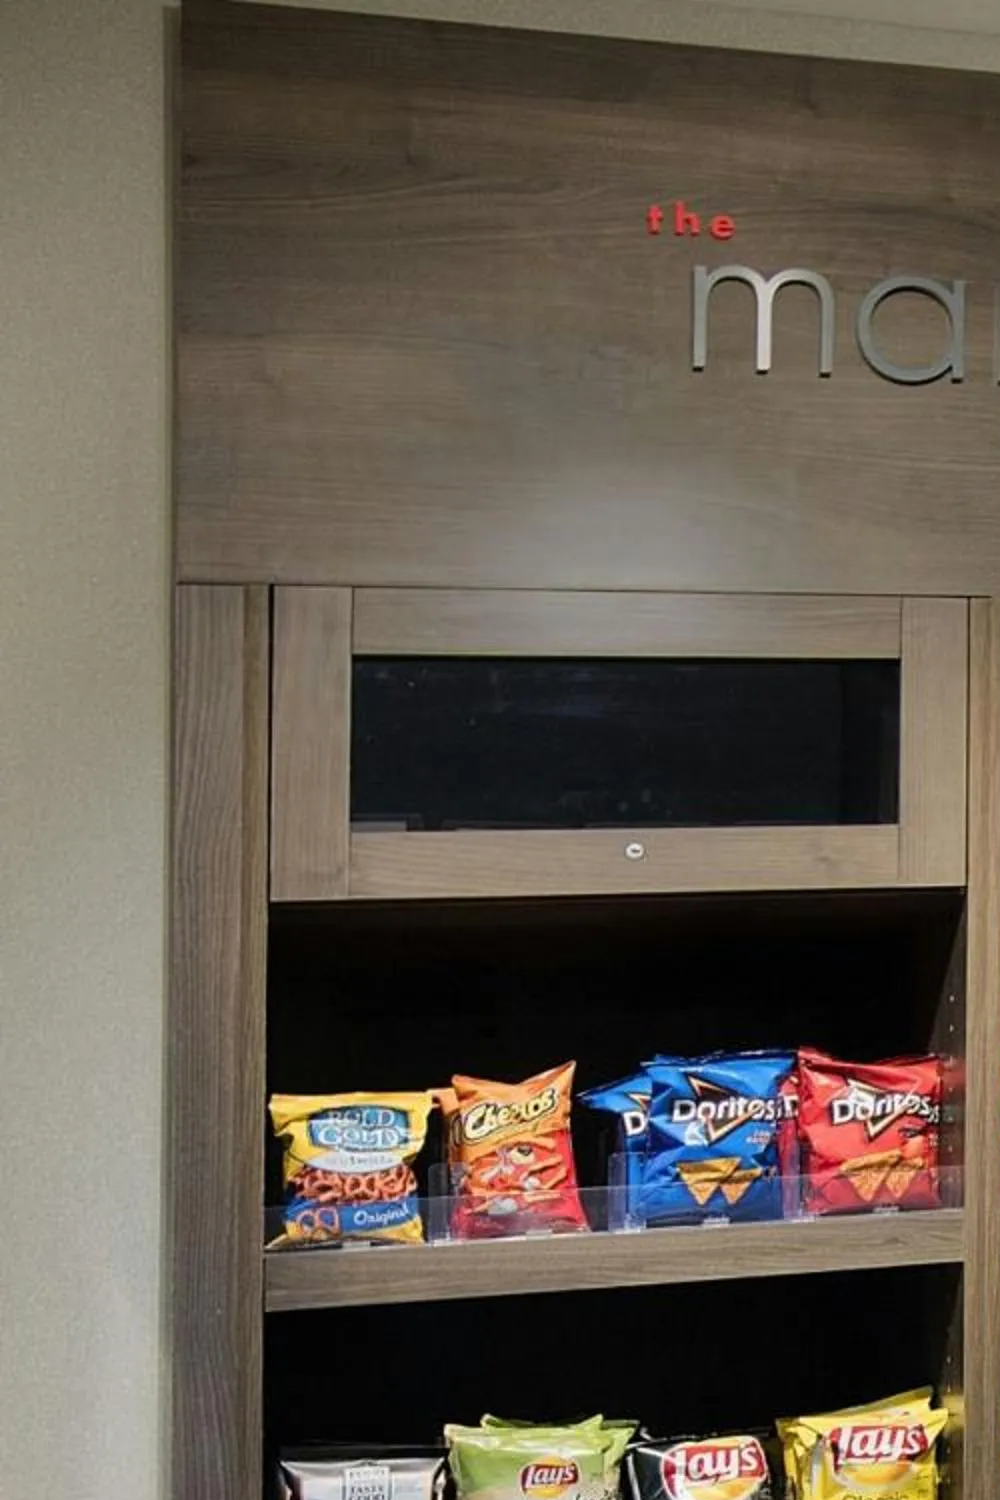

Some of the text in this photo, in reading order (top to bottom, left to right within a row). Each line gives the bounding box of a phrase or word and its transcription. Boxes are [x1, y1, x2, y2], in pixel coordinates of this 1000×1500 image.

[646, 202, 735, 240] the
[672, 1096, 776, 1123] Doritos
[832, 1094, 932, 1125] Doritos
